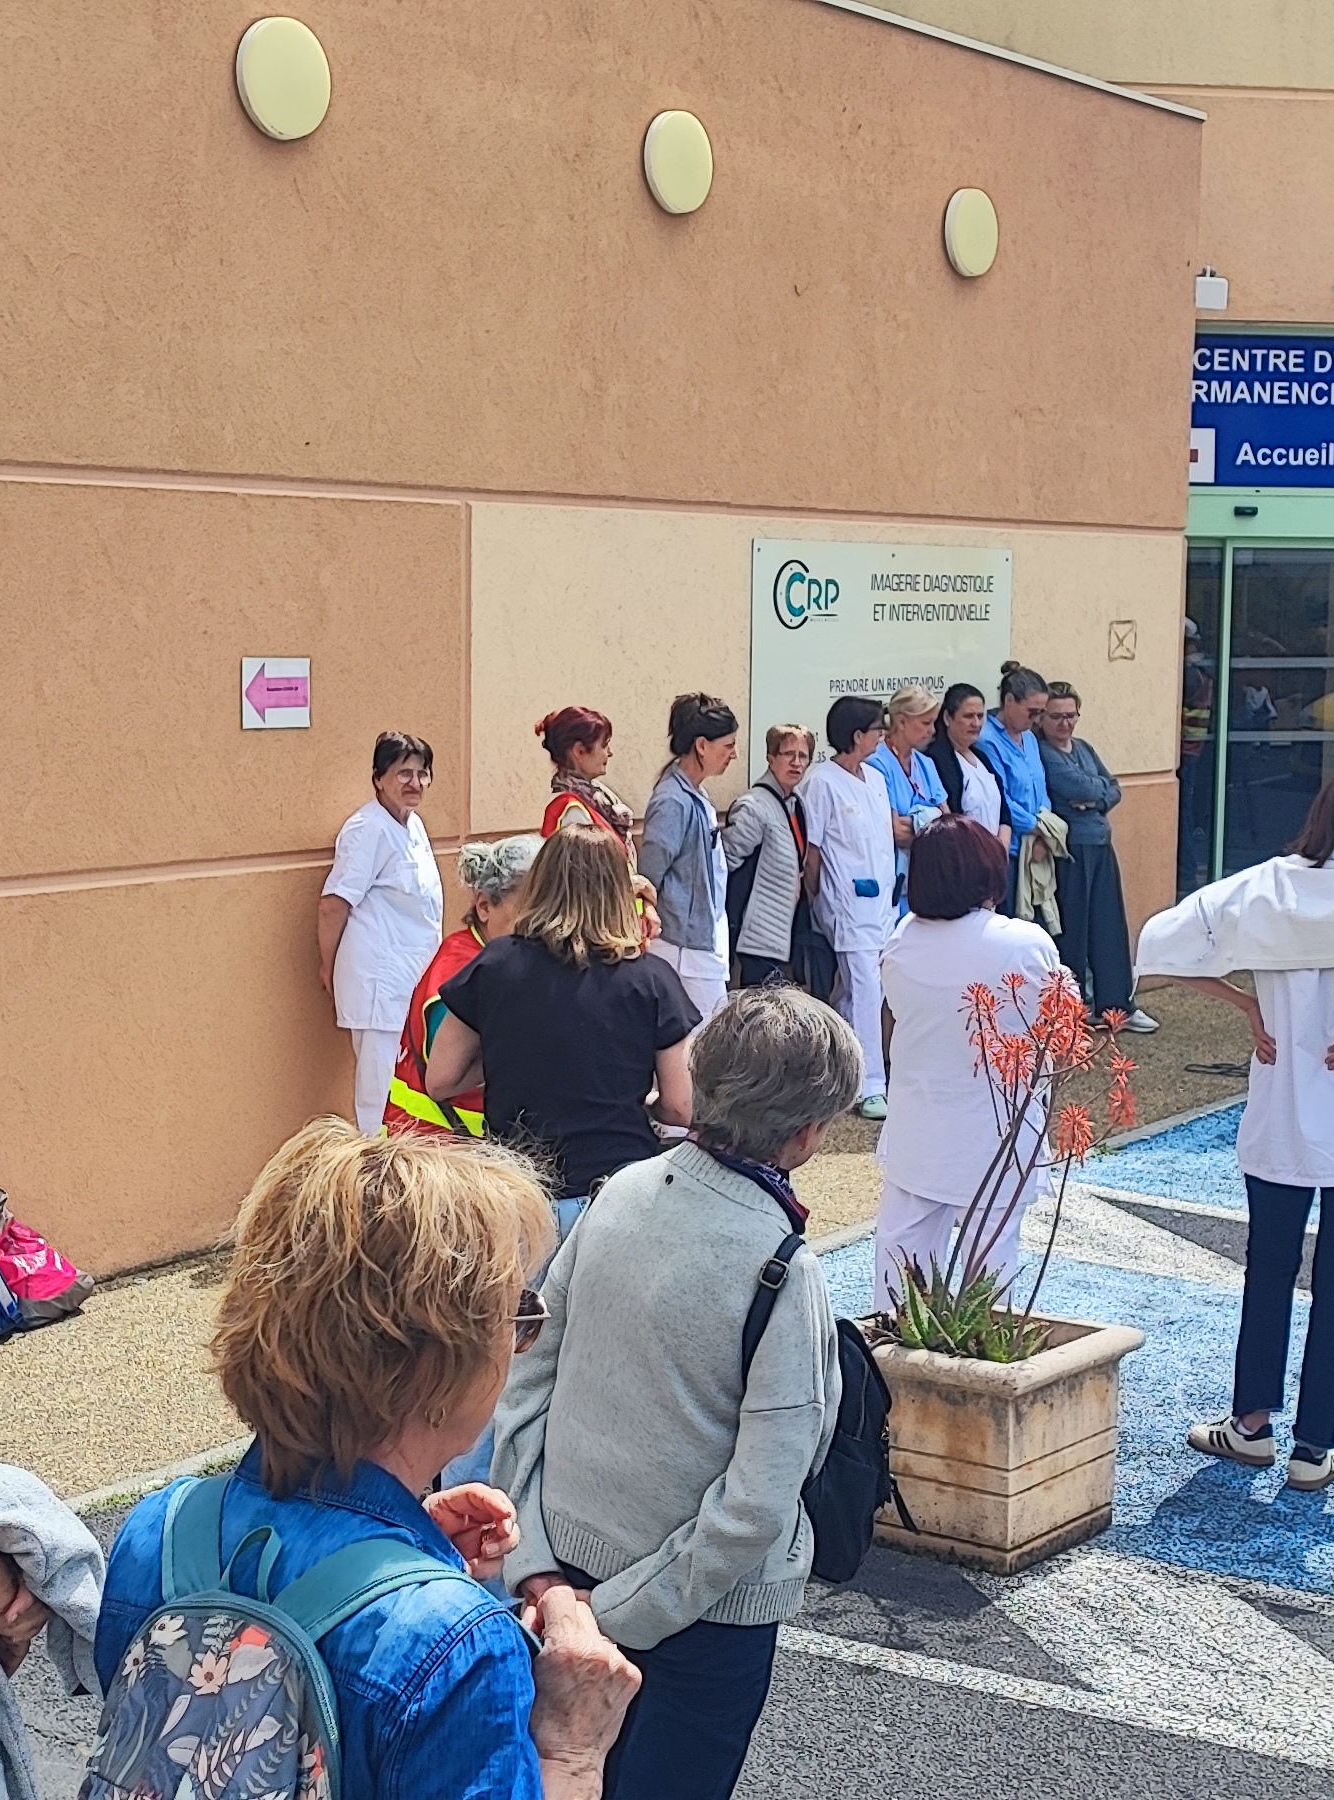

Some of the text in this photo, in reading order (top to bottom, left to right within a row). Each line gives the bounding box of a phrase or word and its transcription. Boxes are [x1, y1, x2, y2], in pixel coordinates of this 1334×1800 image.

[1193, 348, 1306, 373] CENTRE
[1235, 442, 1334, 466] Accueil
[870, 573, 995, 593] IMAGERIE DIAGNOSTIQUE
[873, 603, 991, 622] ET INTERVENTIONNELLE
[829, 679, 870, 693] PRENDRE
[871, 678, 885, 692] UN
